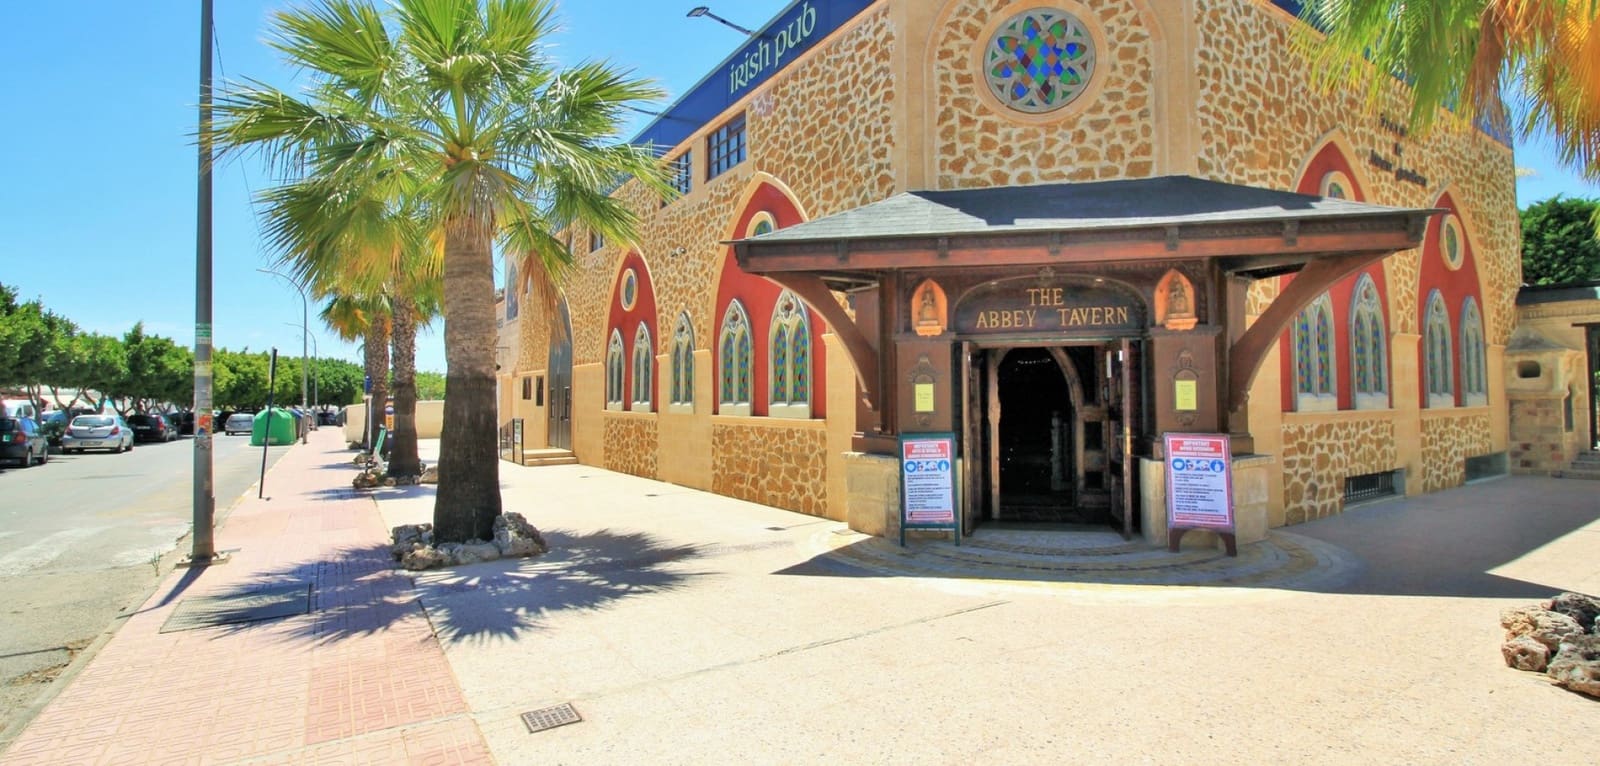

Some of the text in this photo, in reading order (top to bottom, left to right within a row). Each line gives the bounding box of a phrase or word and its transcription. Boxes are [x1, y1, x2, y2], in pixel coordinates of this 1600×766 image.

[774, 1, 816, 68] pub
[1026, 288, 1065, 306] THE
[976, 306, 1129, 329] ABBEY TAVERN
